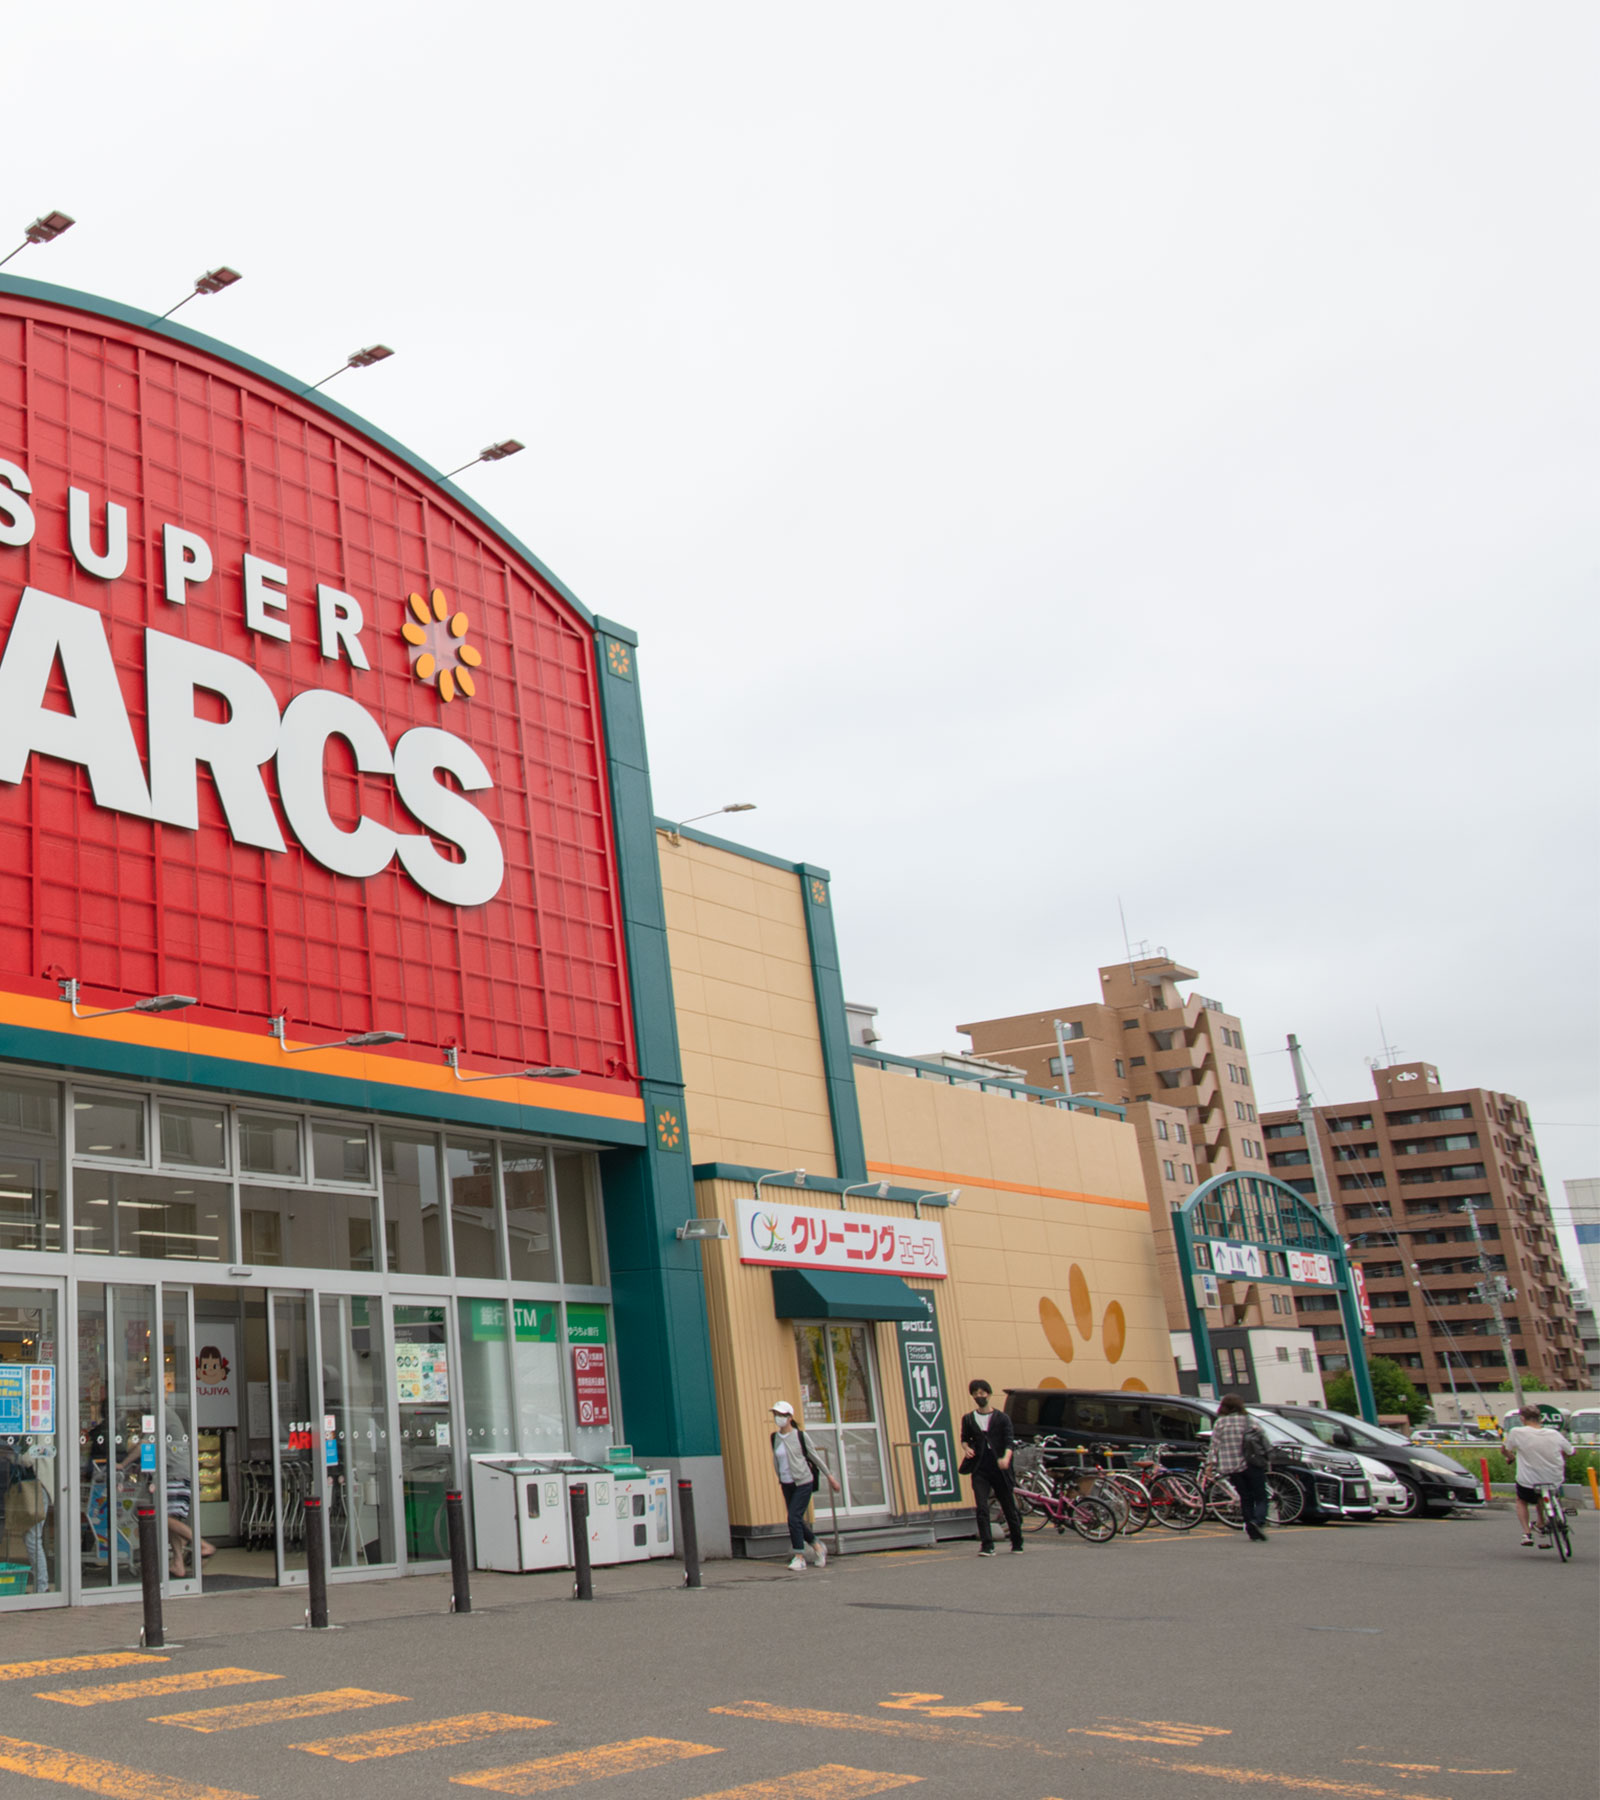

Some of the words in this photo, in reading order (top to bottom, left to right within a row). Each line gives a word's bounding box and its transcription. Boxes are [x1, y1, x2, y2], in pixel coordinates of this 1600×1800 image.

[791, 1216, 895, 1262] クリーニング
[899, 1235, 939, 1267] エース
[1229, 1250, 1244, 1270] IN
[1302, 1259, 1317, 1277] OUT
[513, 1308, 537, 1328] TM
[1541, 1412, 1562, 1423] 入口
